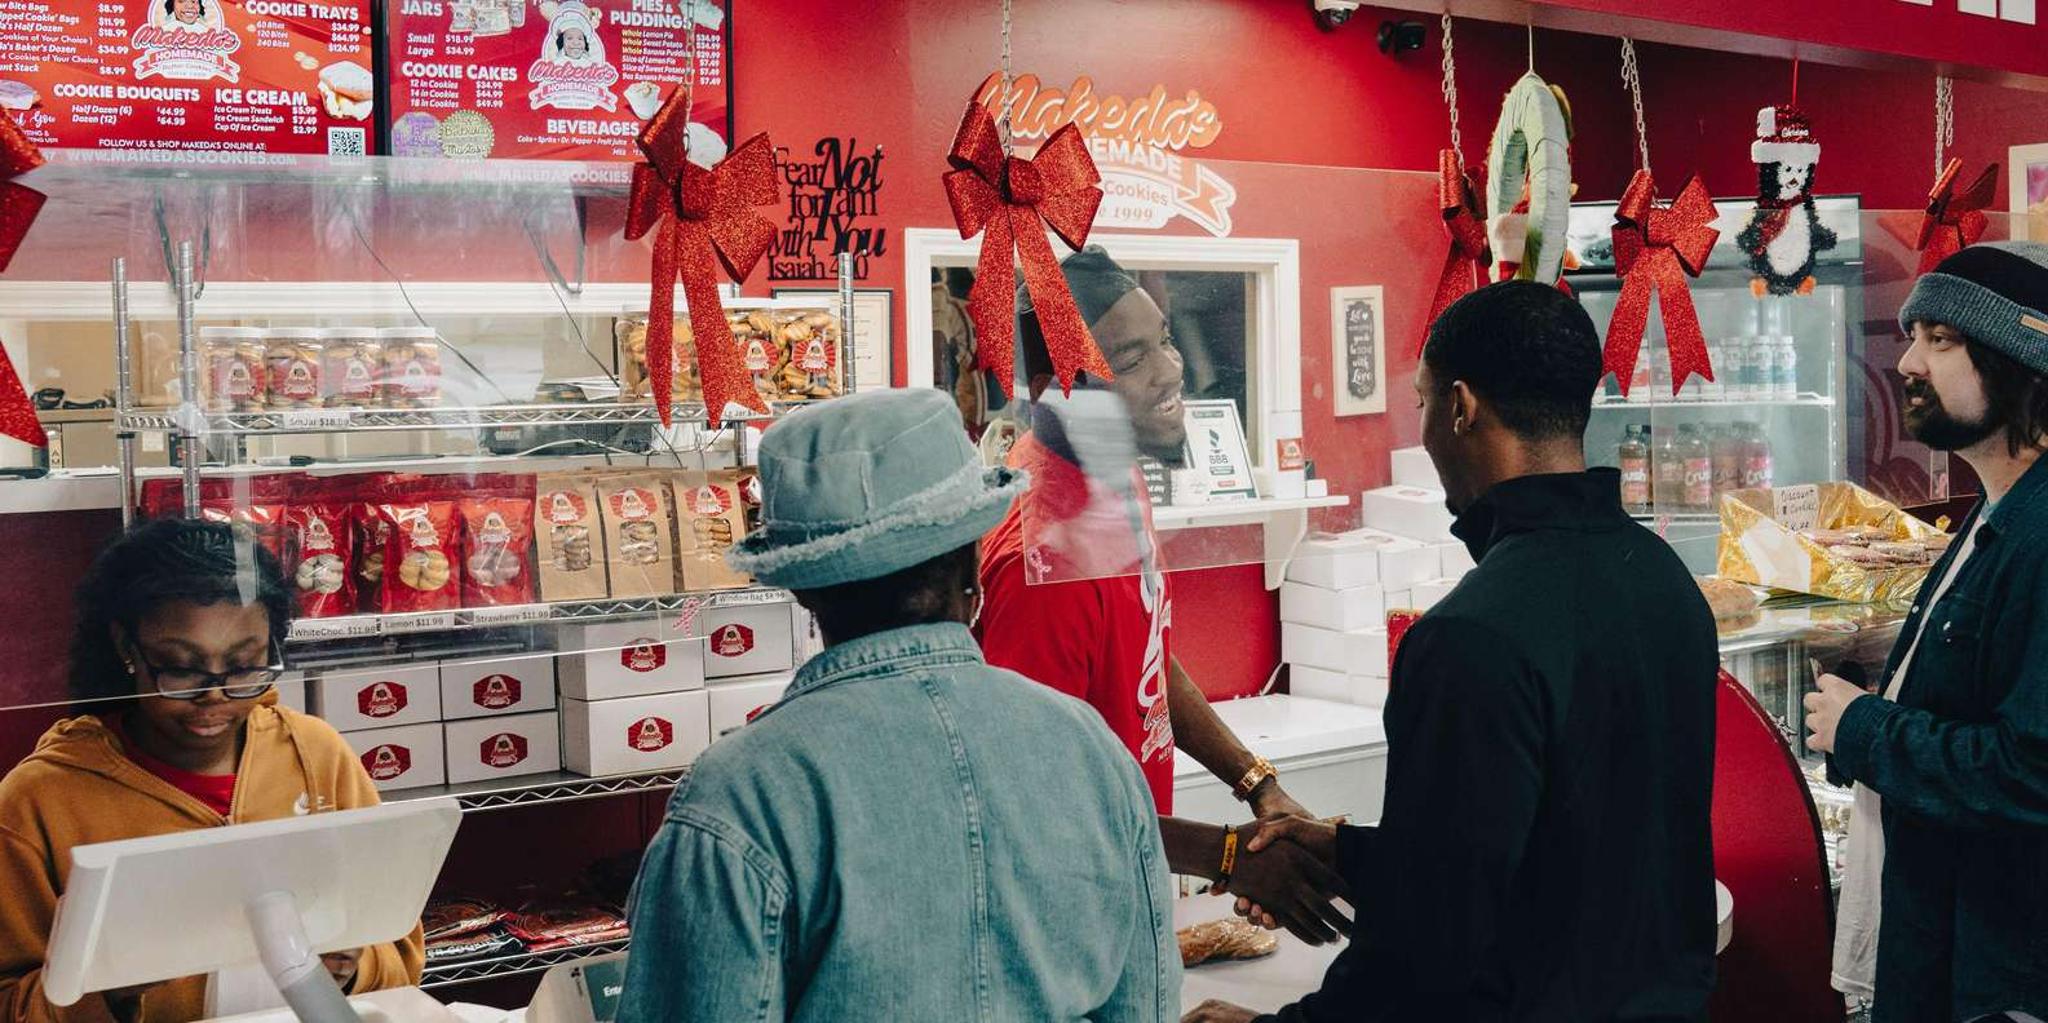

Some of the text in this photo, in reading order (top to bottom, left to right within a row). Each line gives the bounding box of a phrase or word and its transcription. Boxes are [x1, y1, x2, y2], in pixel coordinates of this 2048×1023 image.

[8, 2, 26, 10] Bite
[28, 3, 49, 12] Bags
[246, 0, 359, 20] COOKIE TRAYS
[400, 0, 674, 17] JARS PIES &
[59, 15, 80, 25] Bags
[98, 18, 126, 27] $11.99
[15, 23, 34, 32] Half
[35, 24, 63, 32] Dozen
[332, 23, 360, 32] $34.99
[41, 35, 59, 43] Your
[271, 31, 288, 39] Bites
[407, 33, 475, 44] Small $18.99
[15, 43, 46, 52] Baker's
[48, 45, 76, 53] Dozen
[98, 46, 129, 55] $34.99
[273, 40, 290, 48] Bites
[328, 43, 360, 52] $124.99
[407, 45, 475, 57] Large $34.99
[8, 53, 40, 61] Cookies
[52, 54, 70, 62] Your
[15, 64, 39, 72] Stack
[401, 62, 518, 81] COOKIE CAKES
[429, 81, 459, 89] Cookies
[53, 84, 201, 101] COOKIE BOUQUETS
[215, 88, 309, 107] ICE CREAM
[410, 89, 420, 97] 14
[429, 90, 459, 99] Cookies
[429, 99, 460, 108] Cookies
[72, 104, 91, 115] Half
[92, 105, 118, 114] Dozen
[214, 105, 225, 113] Ice
[226, 105, 249, 114] Cream
[250, 106, 273, 114] Treats
[966, 71, 1223, 149] Makeda's
[72, 114, 98, 123] Dozen
[100, 114, 117, 125] (12)
[214, 114, 225, 122] Ice
[226, 114, 249, 122] Cream
[251, 115, 285, 123] Sandwich
[214, 123, 229, 133] Cup
[230, 123, 240, 132] Of
[252, 124, 276, 132] Cream
[292, 125, 318, 134] $2.99
[547, 119, 640, 137] BEVERAGES
[98, 139, 134, 147] FOLLOW
[137, 139, 148, 148] US
[156, 140, 181, 149] SHOP
[181, 141, 222, 150] MAKEDA'S
[223, 142, 254, 150] ONLINE
[572, 136, 594, 146] Pepper
[1085, 138, 1184, 181] EMADE
[773, 137, 885, 196] Fear Not
[1104, 180, 1168, 207] Cookies
[787, 185, 826, 224] for
[836, 187, 878, 217] am
[1115, 206, 1154, 222] 1999
[828, 214, 887, 258] You
[767, 253, 826, 281] Isaiah
[415, 617, 444, 627] $11.99
[475, 611, 549, 624] Strawberry $11.99
